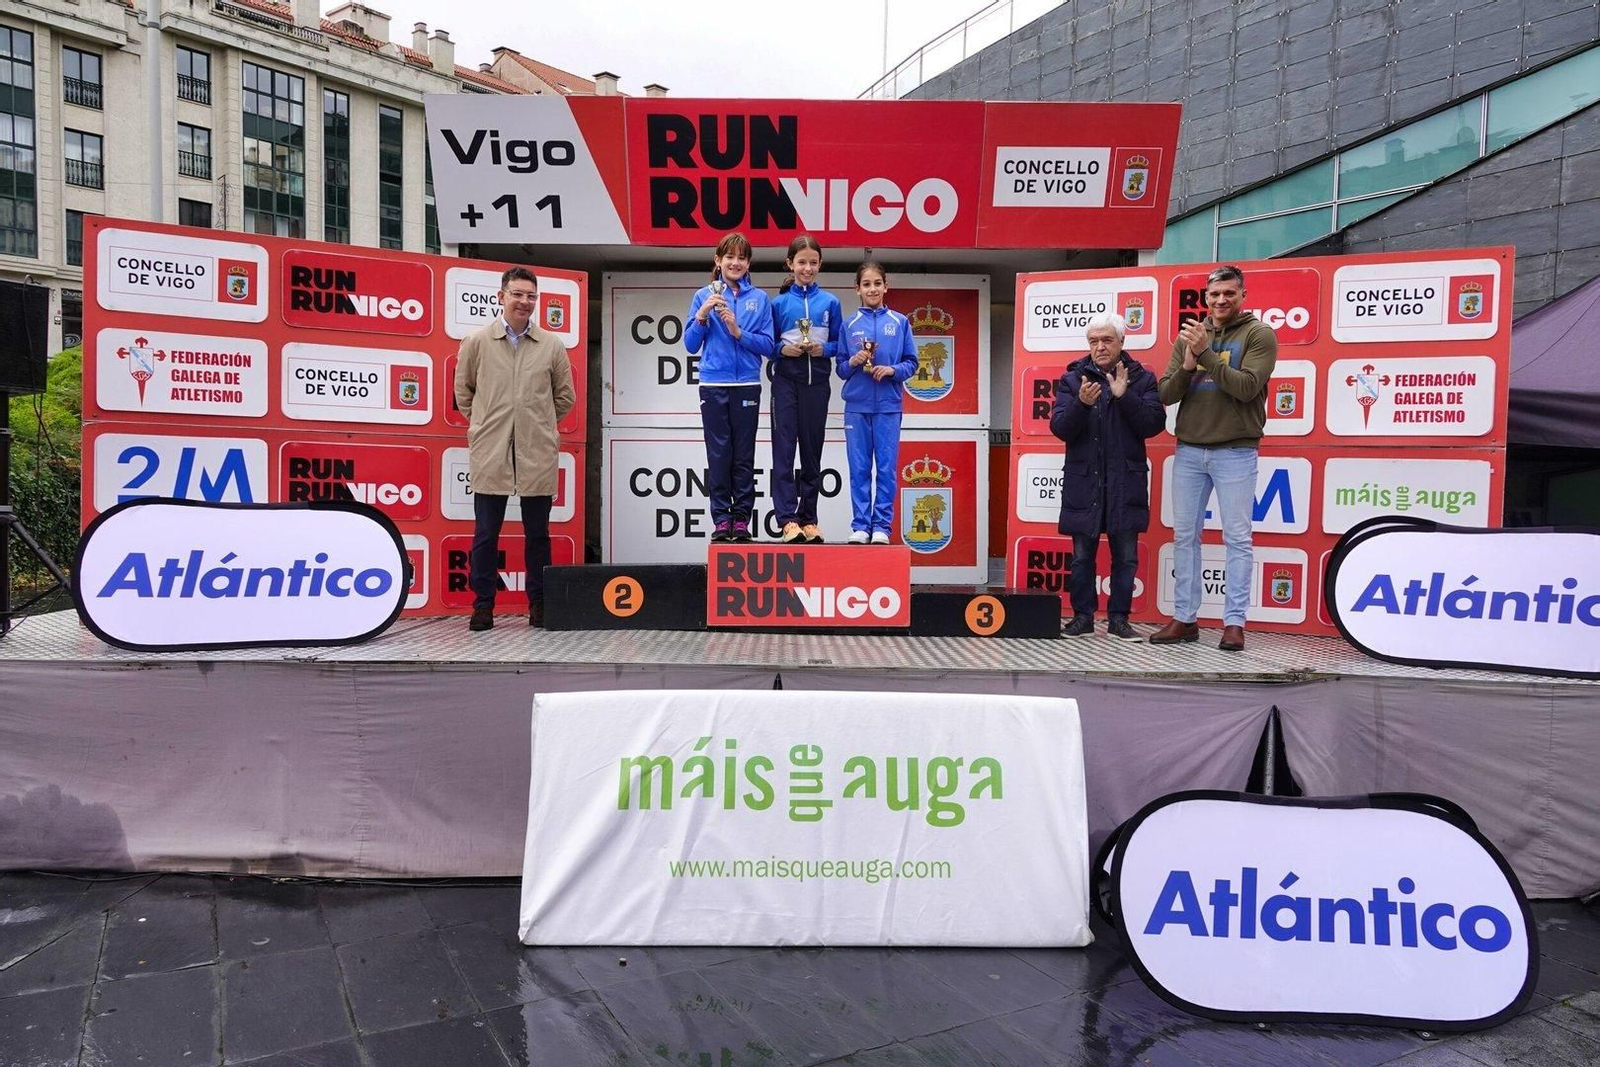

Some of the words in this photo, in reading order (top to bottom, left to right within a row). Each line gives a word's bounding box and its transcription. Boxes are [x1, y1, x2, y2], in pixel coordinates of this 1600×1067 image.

[647, 113, 798, 170] RUN
[440, 129, 576, 173] Vigo
[1003, 160, 1100, 175] CONCELLO
[1014, 179, 1037, 193] DE
[1044, 179, 1087, 194] VIGO
[460, 194, 563, 228] +11
[117, 257, 205, 276] CONCELLO
[128, 273, 149, 285] DE
[156, 275, 195, 289] VIGO
[290, 265, 356, 292] RUN
[1346, 287, 1435, 302] CONCELLO
[470, 306, 487, 317] DE
[1034, 302, 1106, 316] CONCELLO
[1356, 305, 1377, 317] DE
[1384, 303, 1424, 316] VIGO
[1042, 317, 1060, 329] DE
[170, 350, 252, 368] FEDERACIÓN
[171, 369, 221, 384] GALEGA
[224, 372, 241, 385] DE
[295, 367, 379, 384] CONCELLO
[1394, 371, 1477, 387] FEDERACIÓN
[170, 388, 243, 404] ATLETISMO
[305, 383, 326, 396] DE
[332, 385, 369, 398] VIGO
[1394, 392, 1442, 405] GALEGA
[1446, 392, 1464, 405] DE
[1393, 410, 1466, 423] ATLETISMO
[289, 457, 355, 480] RUN
[1039, 489, 1056, 499] DE
[1335, 483, 1392, 507] máis
[1395, 486, 1412, 511] que
[1416, 490, 1477, 514] auga
[656, 508, 706, 538] DE
[96, 549, 393, 599] Atlántico
[717, 552, 805, 582] RUN
[614, 584, 632, 610] 2
[976, 602, 994, 628] 3
[617, 736, 775, 811] máis
[789, 743, 833, 823] que
[842, 756, 1004, 828] auga
[669, 855, 952, 884] www.maisqueauga.com
[1143, 867, 1512, 953] Atlántico
